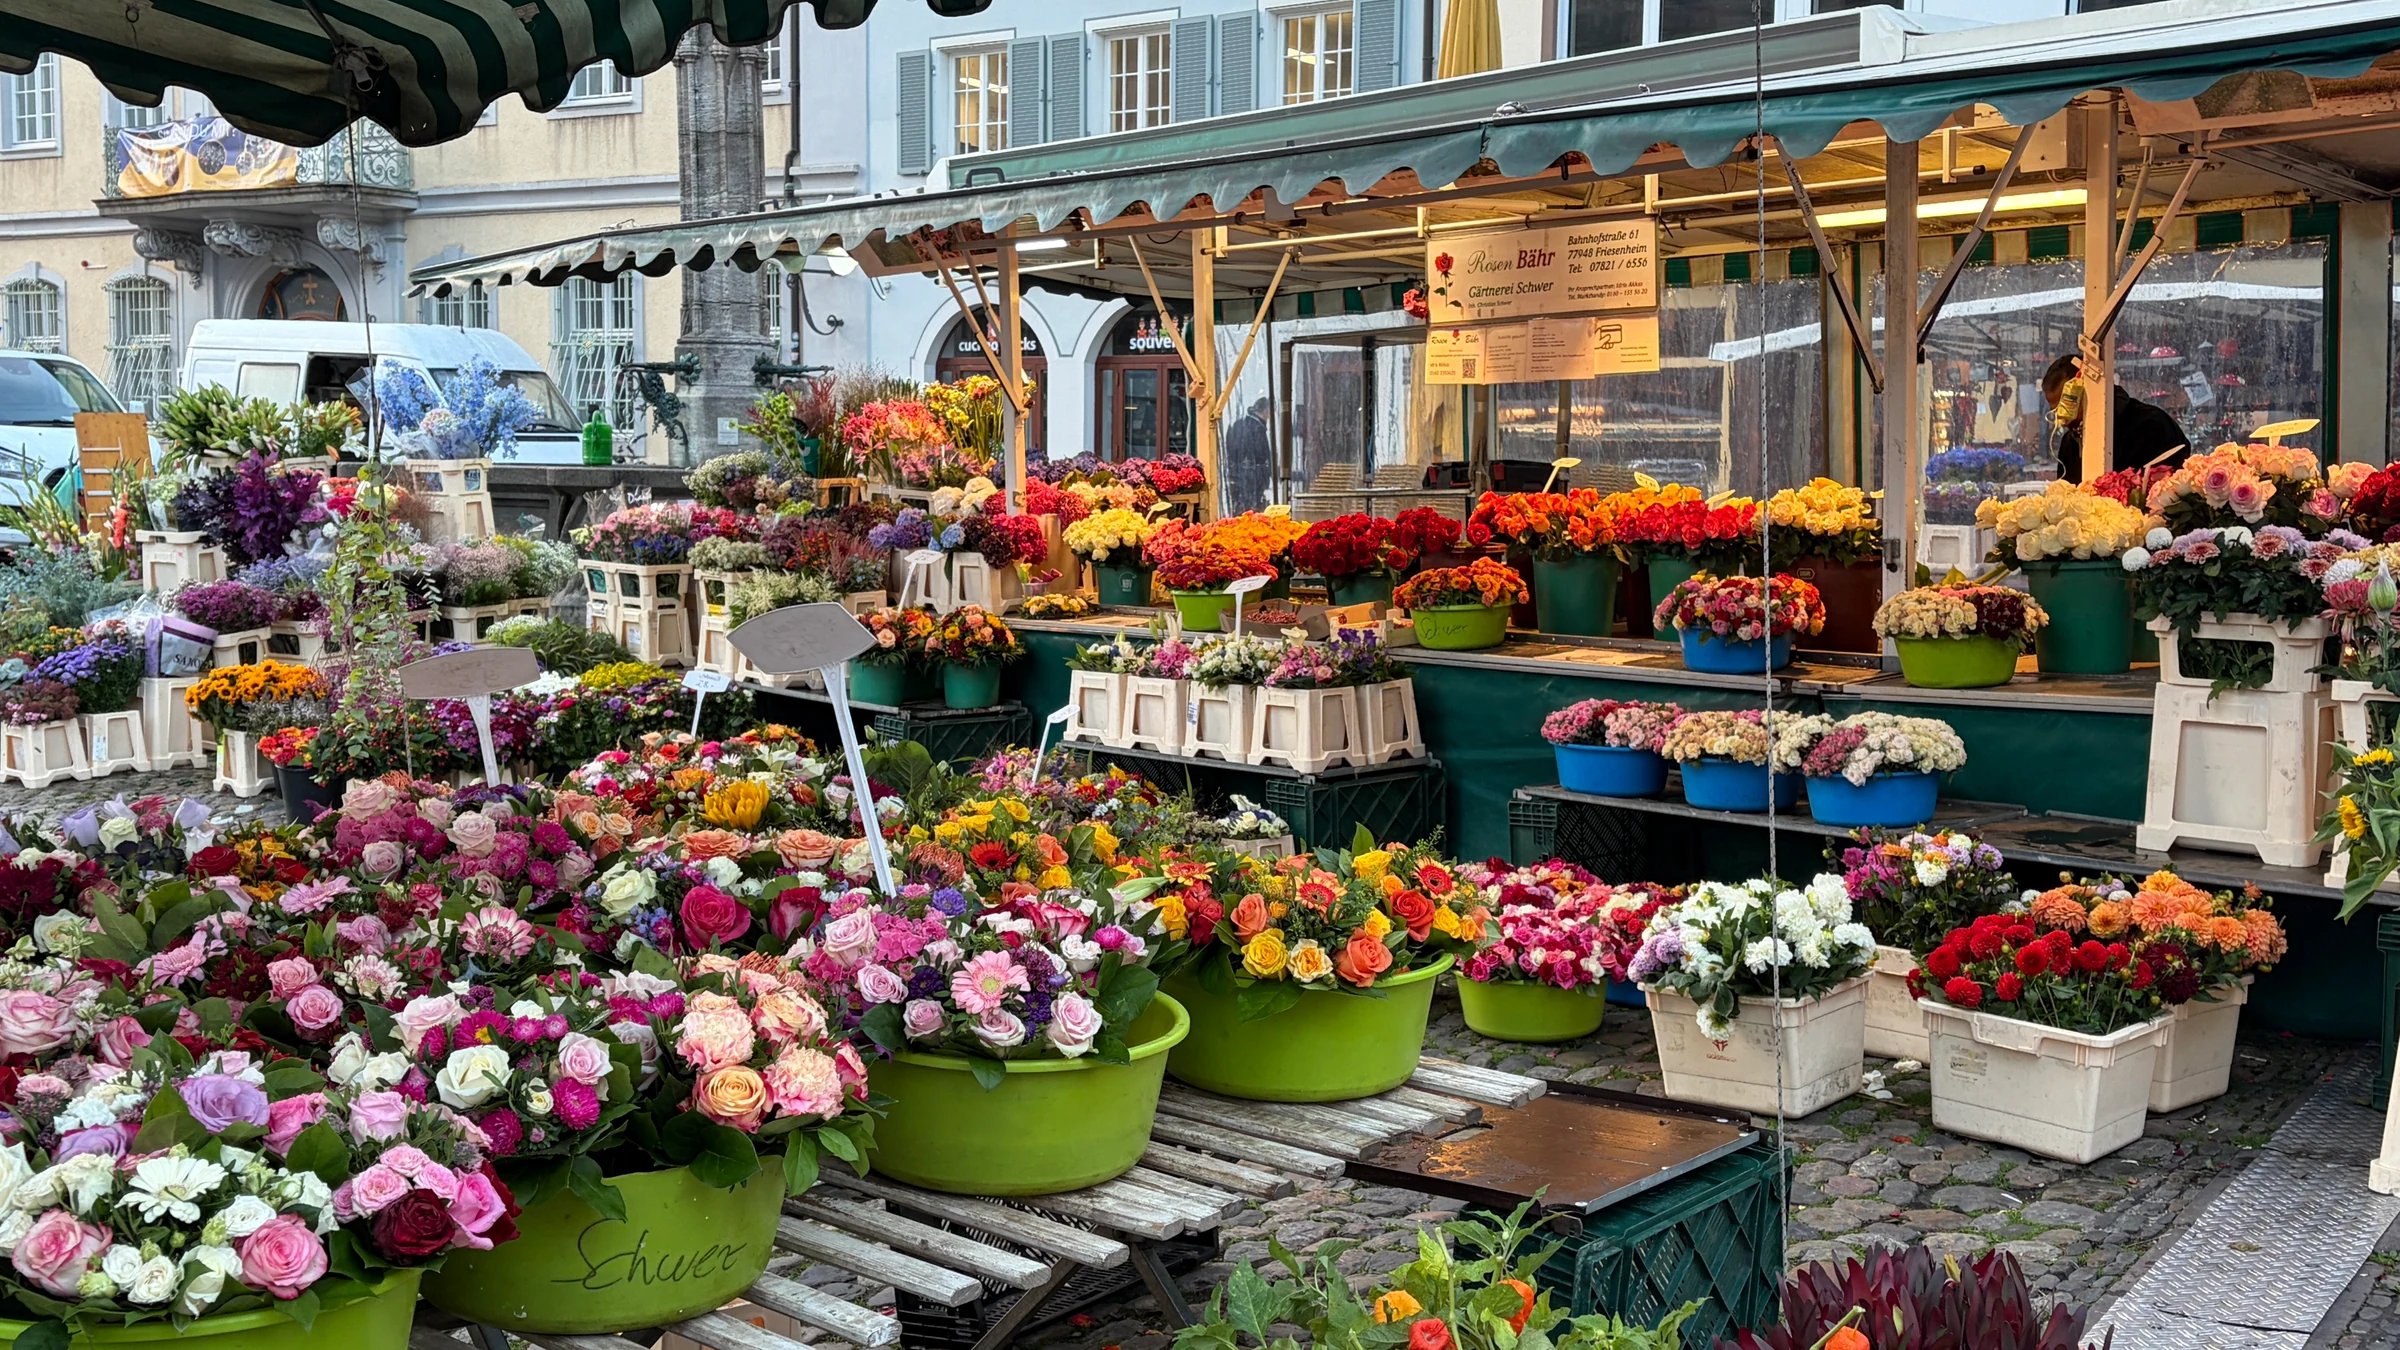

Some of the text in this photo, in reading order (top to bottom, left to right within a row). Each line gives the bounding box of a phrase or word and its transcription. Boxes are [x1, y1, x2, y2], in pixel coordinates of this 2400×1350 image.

[1568, 229, 1639, 246] Bahnhofstraße 61
[1568, 244, 1647, 260] 77948 Friesenheim
[1467, 248, 1556, 274] Rosen Bähr
[1590, 260, 1615, 272] 07821
[1617, 259, 1624, 269] /
[1626, 257, 1648, 269] 6556
[1468, 281, 1554, 298] Gärtnerei Schwer
[551, 1218, 748, 1290] Schwer
